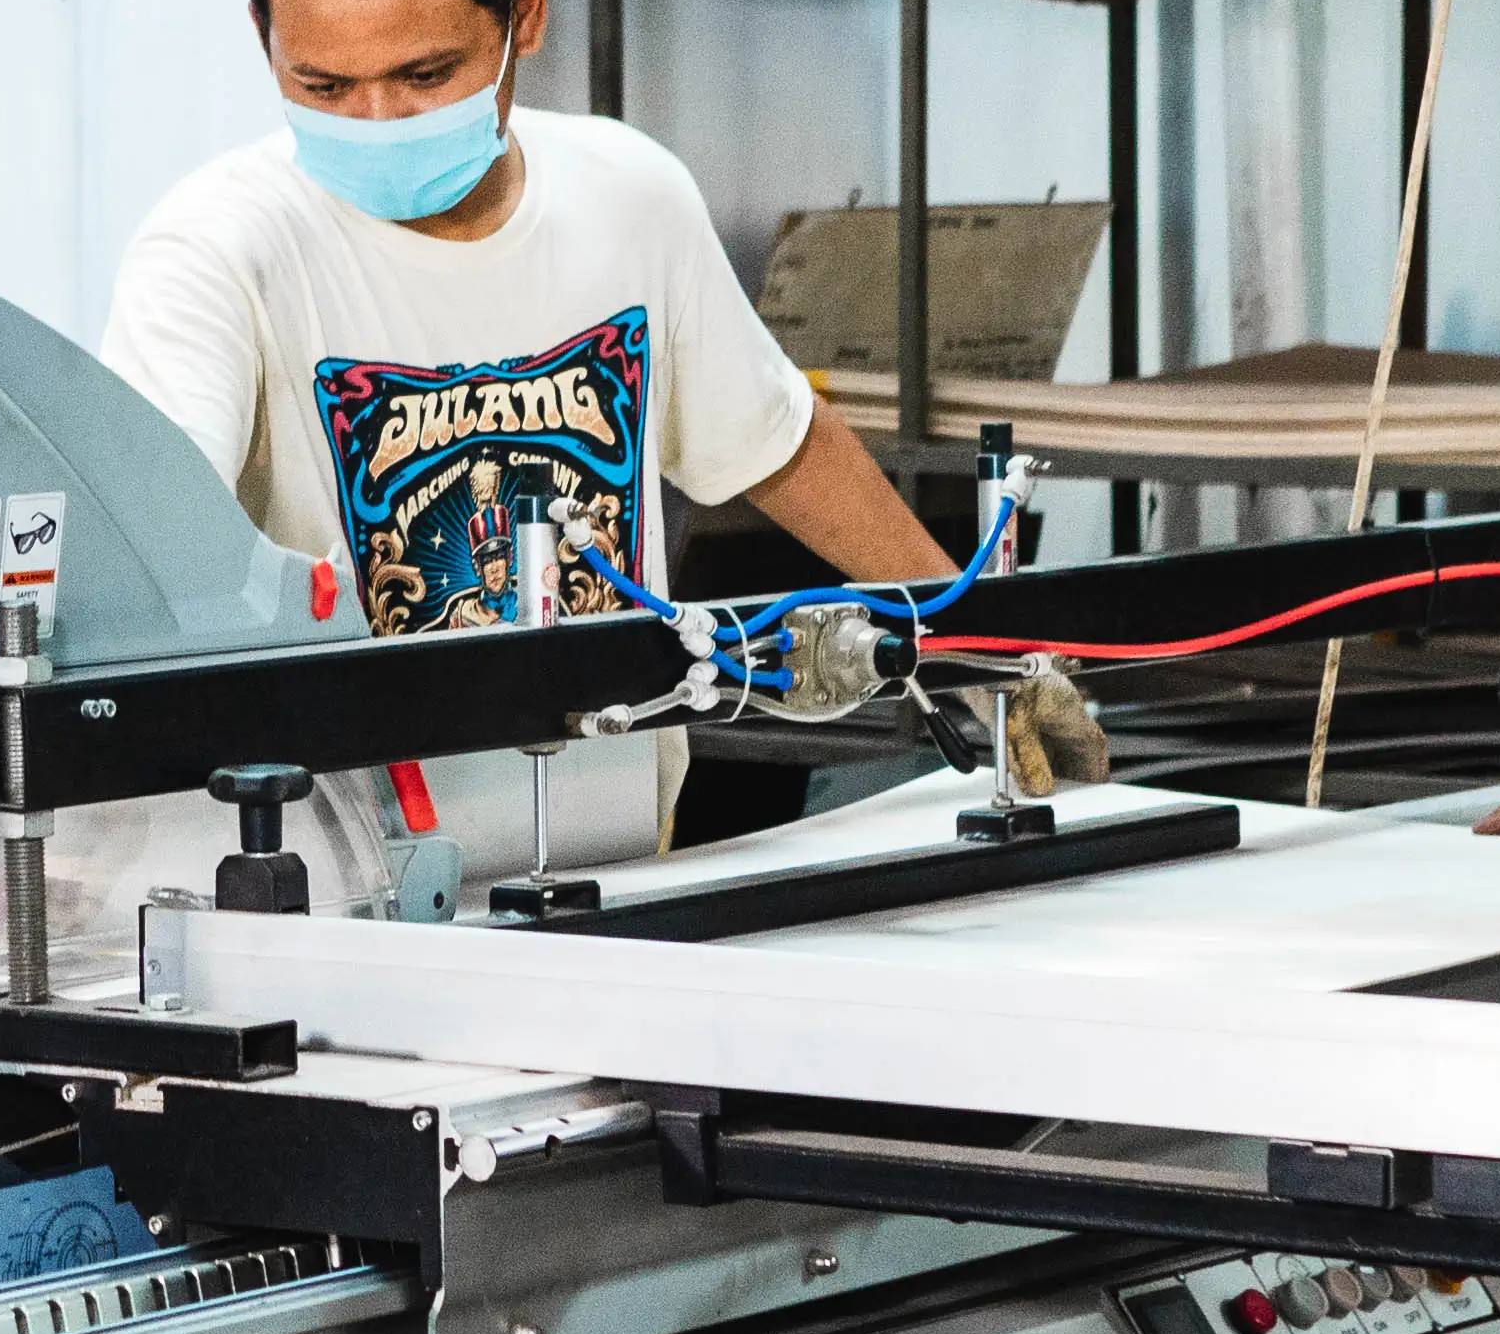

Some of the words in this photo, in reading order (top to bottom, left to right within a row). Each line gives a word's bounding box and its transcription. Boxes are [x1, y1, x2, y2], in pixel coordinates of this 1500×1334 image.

[16, 589, 39, 599] SAFETY
[1448, 1296, 1472, 1312] STOP
[1373, 1319, 1389, 1333] ON
[1404, 1310, 1423, 1325] OFF
